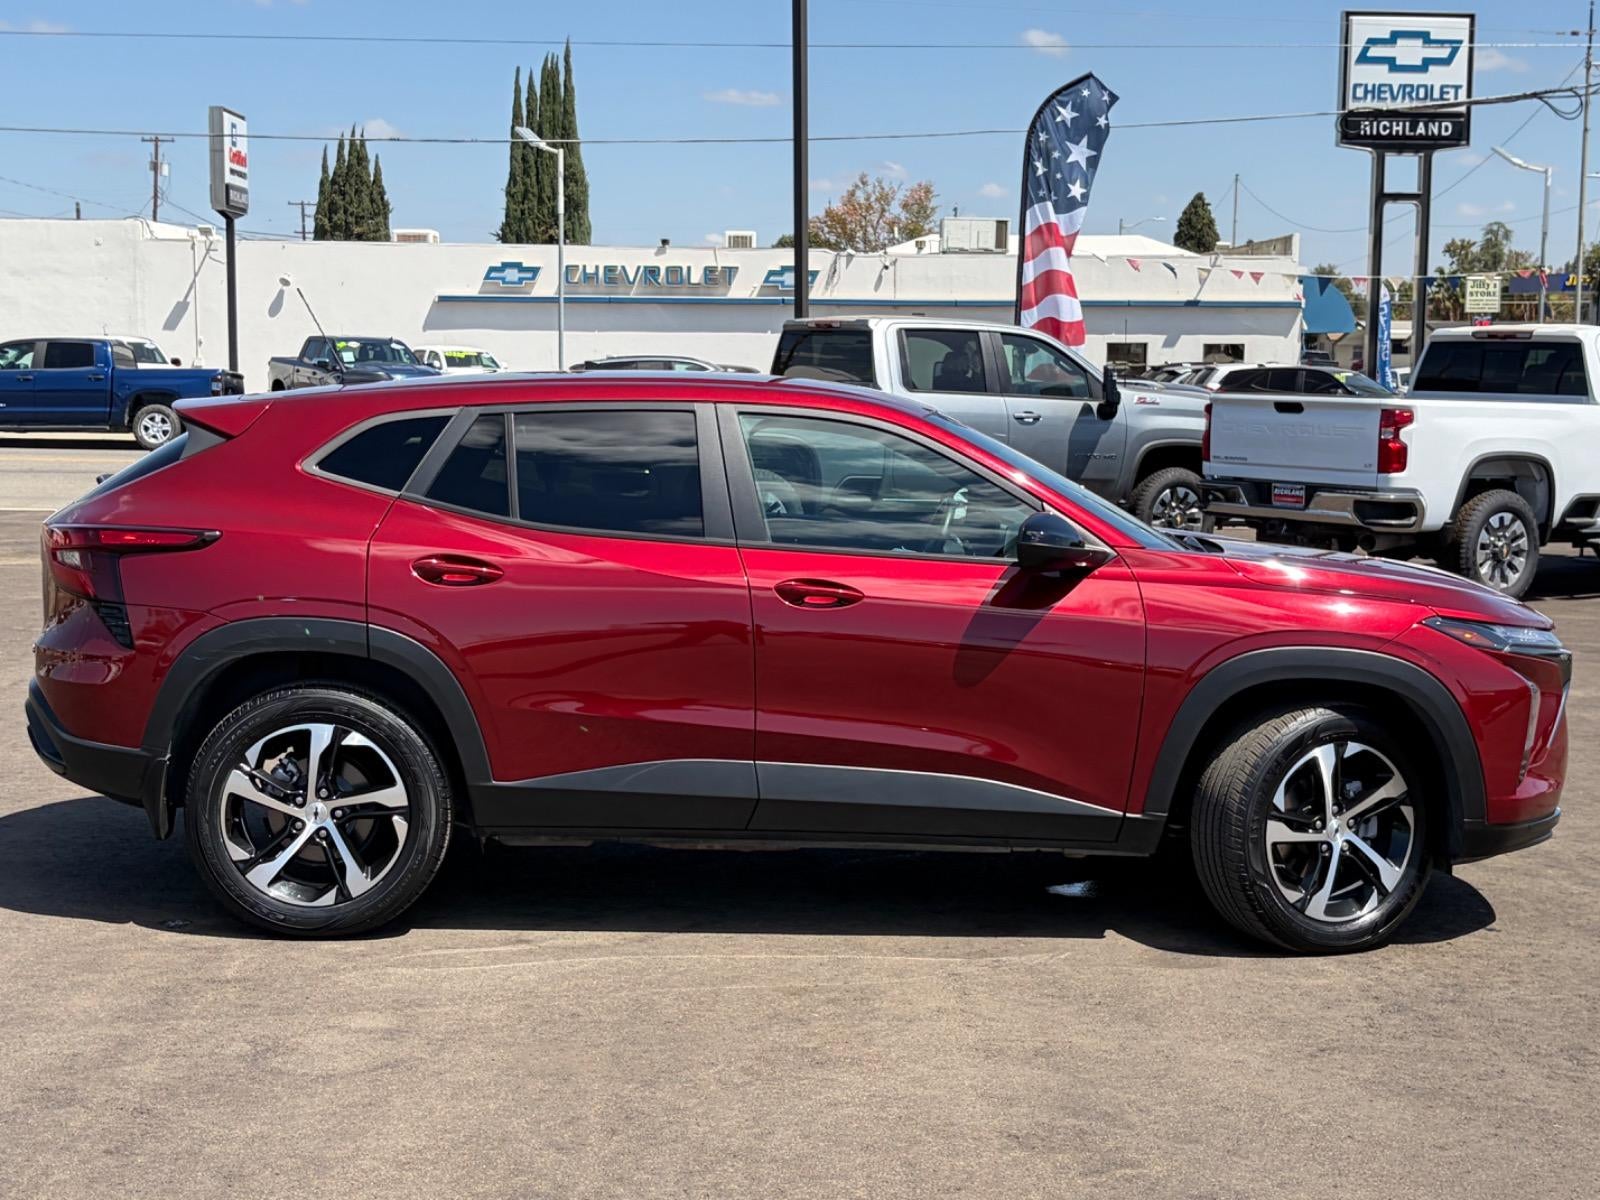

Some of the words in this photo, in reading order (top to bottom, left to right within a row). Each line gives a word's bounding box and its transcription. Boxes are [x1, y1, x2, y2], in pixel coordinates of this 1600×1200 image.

[1352, 83, 1463, 102] CHEVROLET
[1360, 121, 1452, 136] RICHLAND
[564, 264, 739, 286] CHEVROLET
